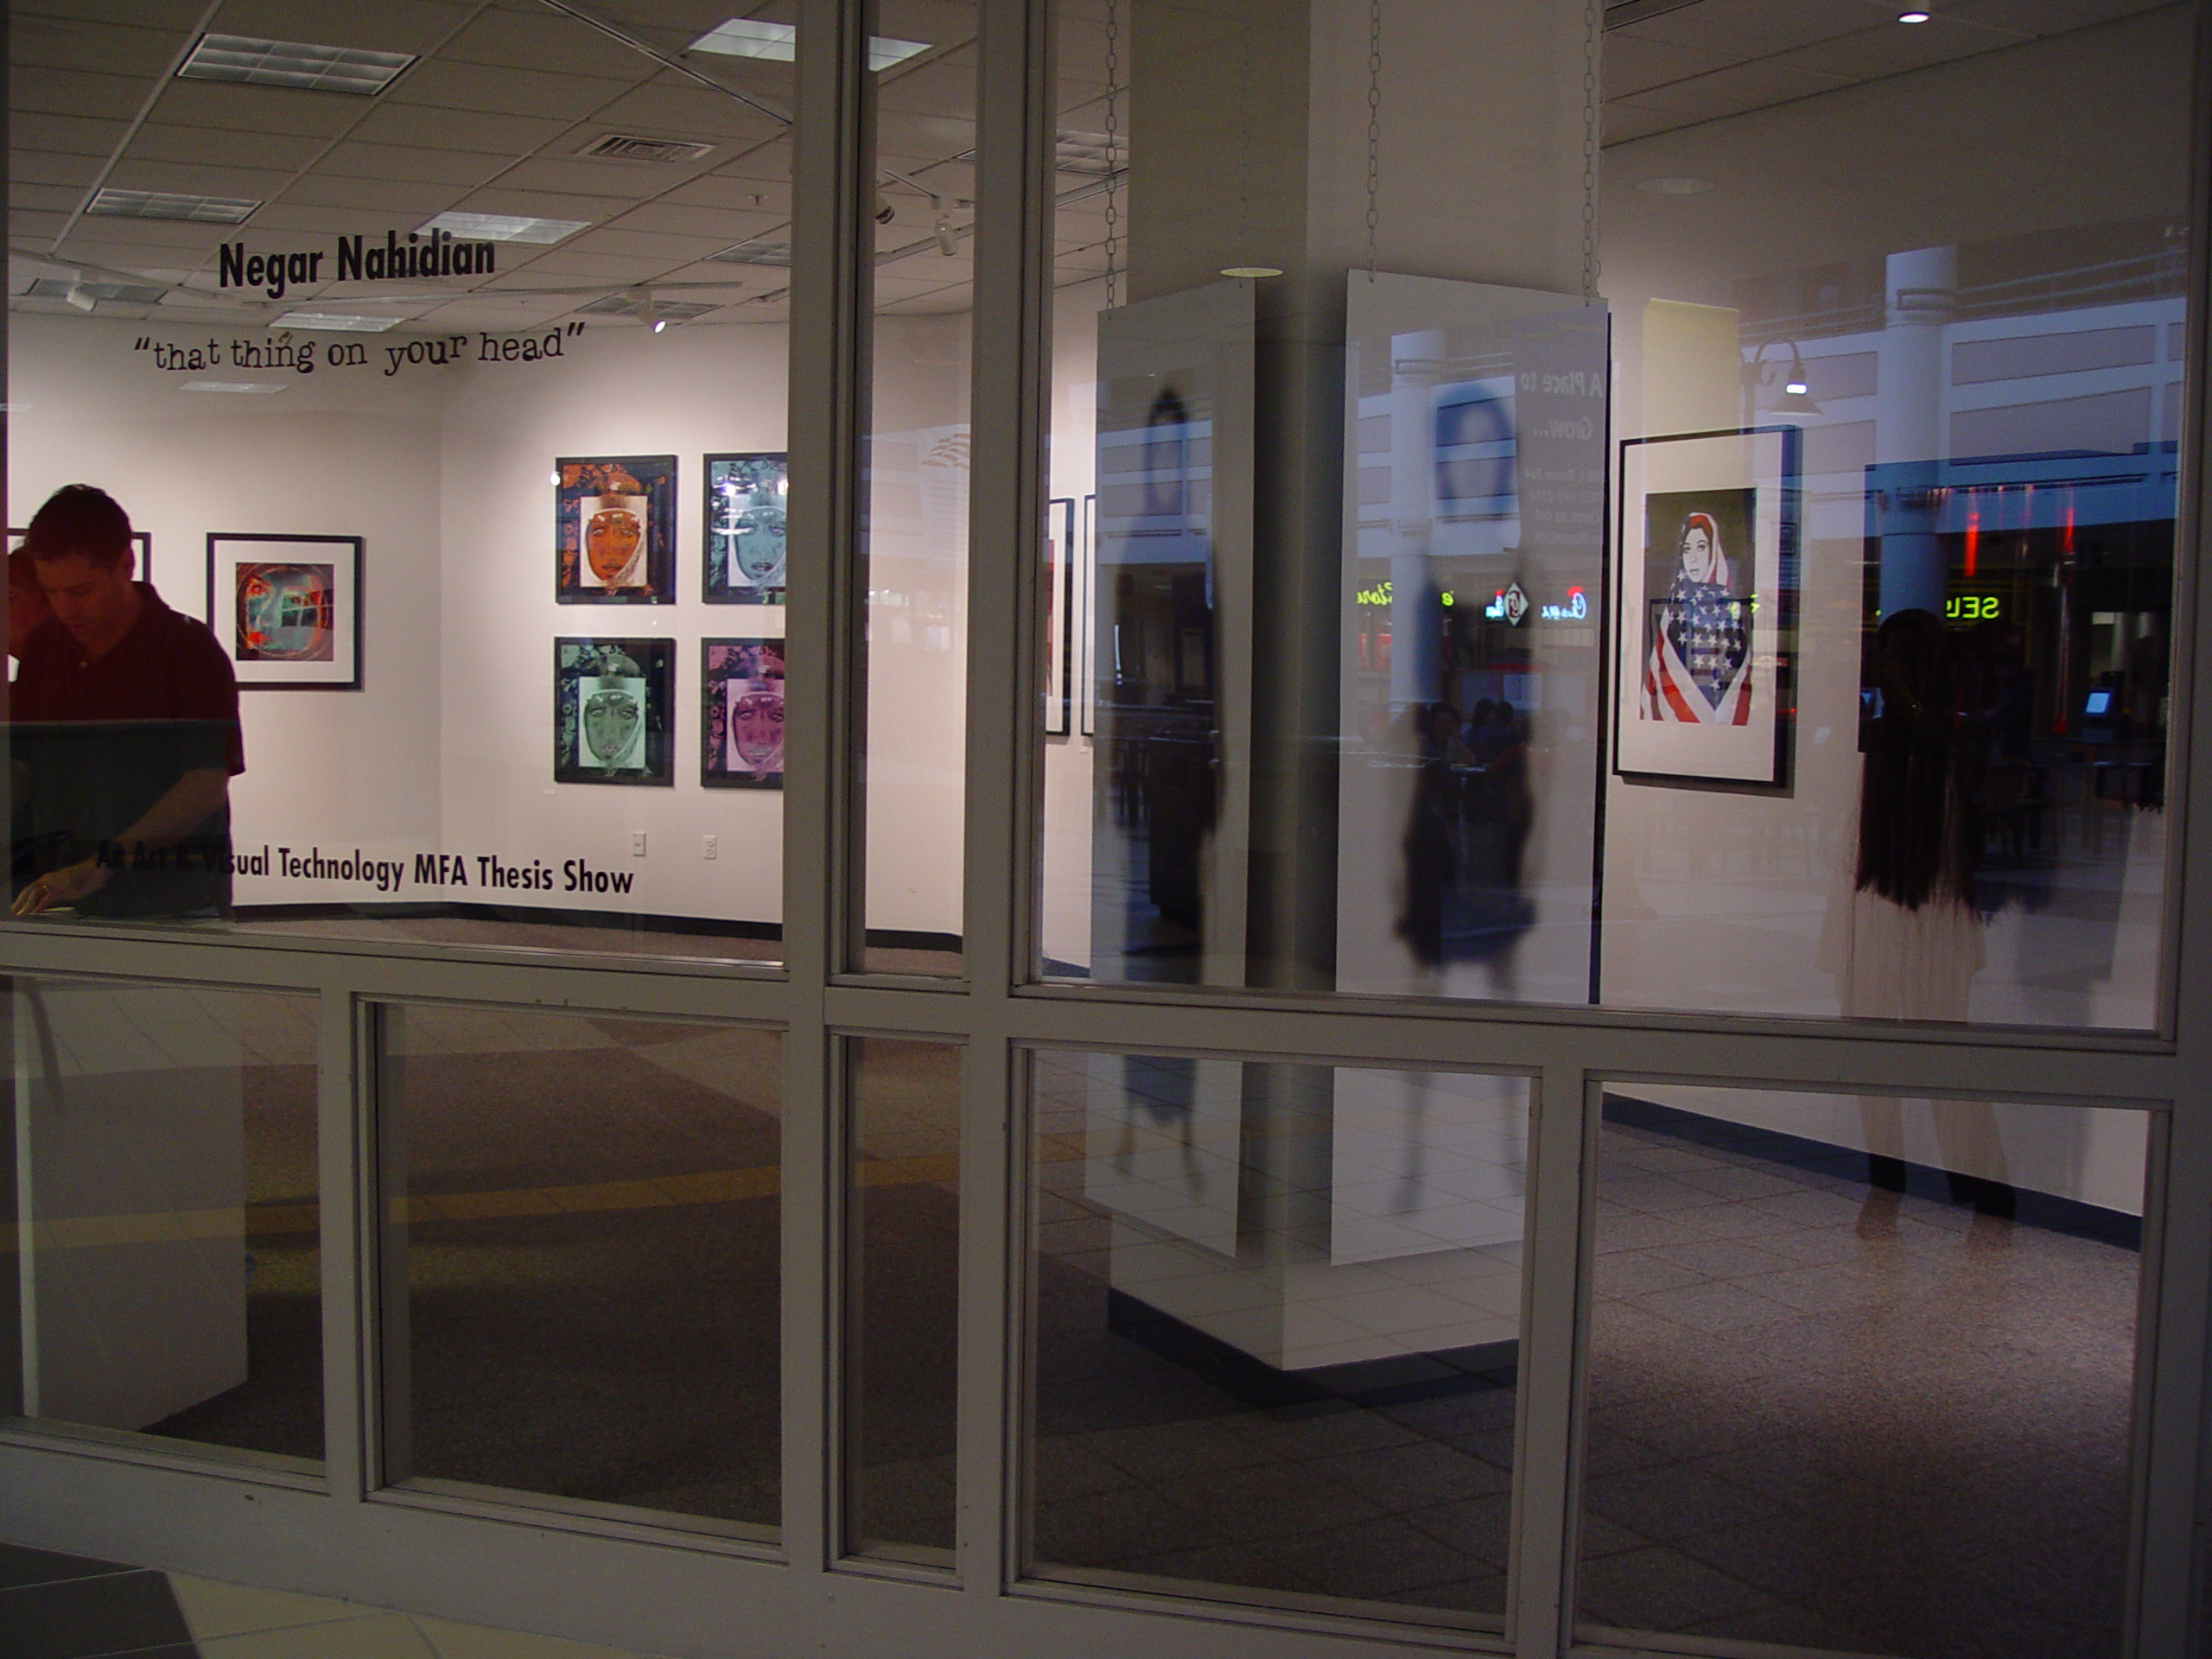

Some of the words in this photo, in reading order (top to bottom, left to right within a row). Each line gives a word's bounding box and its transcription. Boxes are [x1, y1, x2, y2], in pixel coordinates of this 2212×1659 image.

[219, 242, 323, 299] Negar
[337, 228, 495, 282] Nahidian
[231, 340, 316, 374] thing
[327, 349, 368, 366] on
[385, 336, 468, 377] your
[278, 847, 405, 893] Technology
[415, 853, 468, 887] MFA
[477, 855, 553, 891] Thesis
[564, 858, 634, 894] Show
